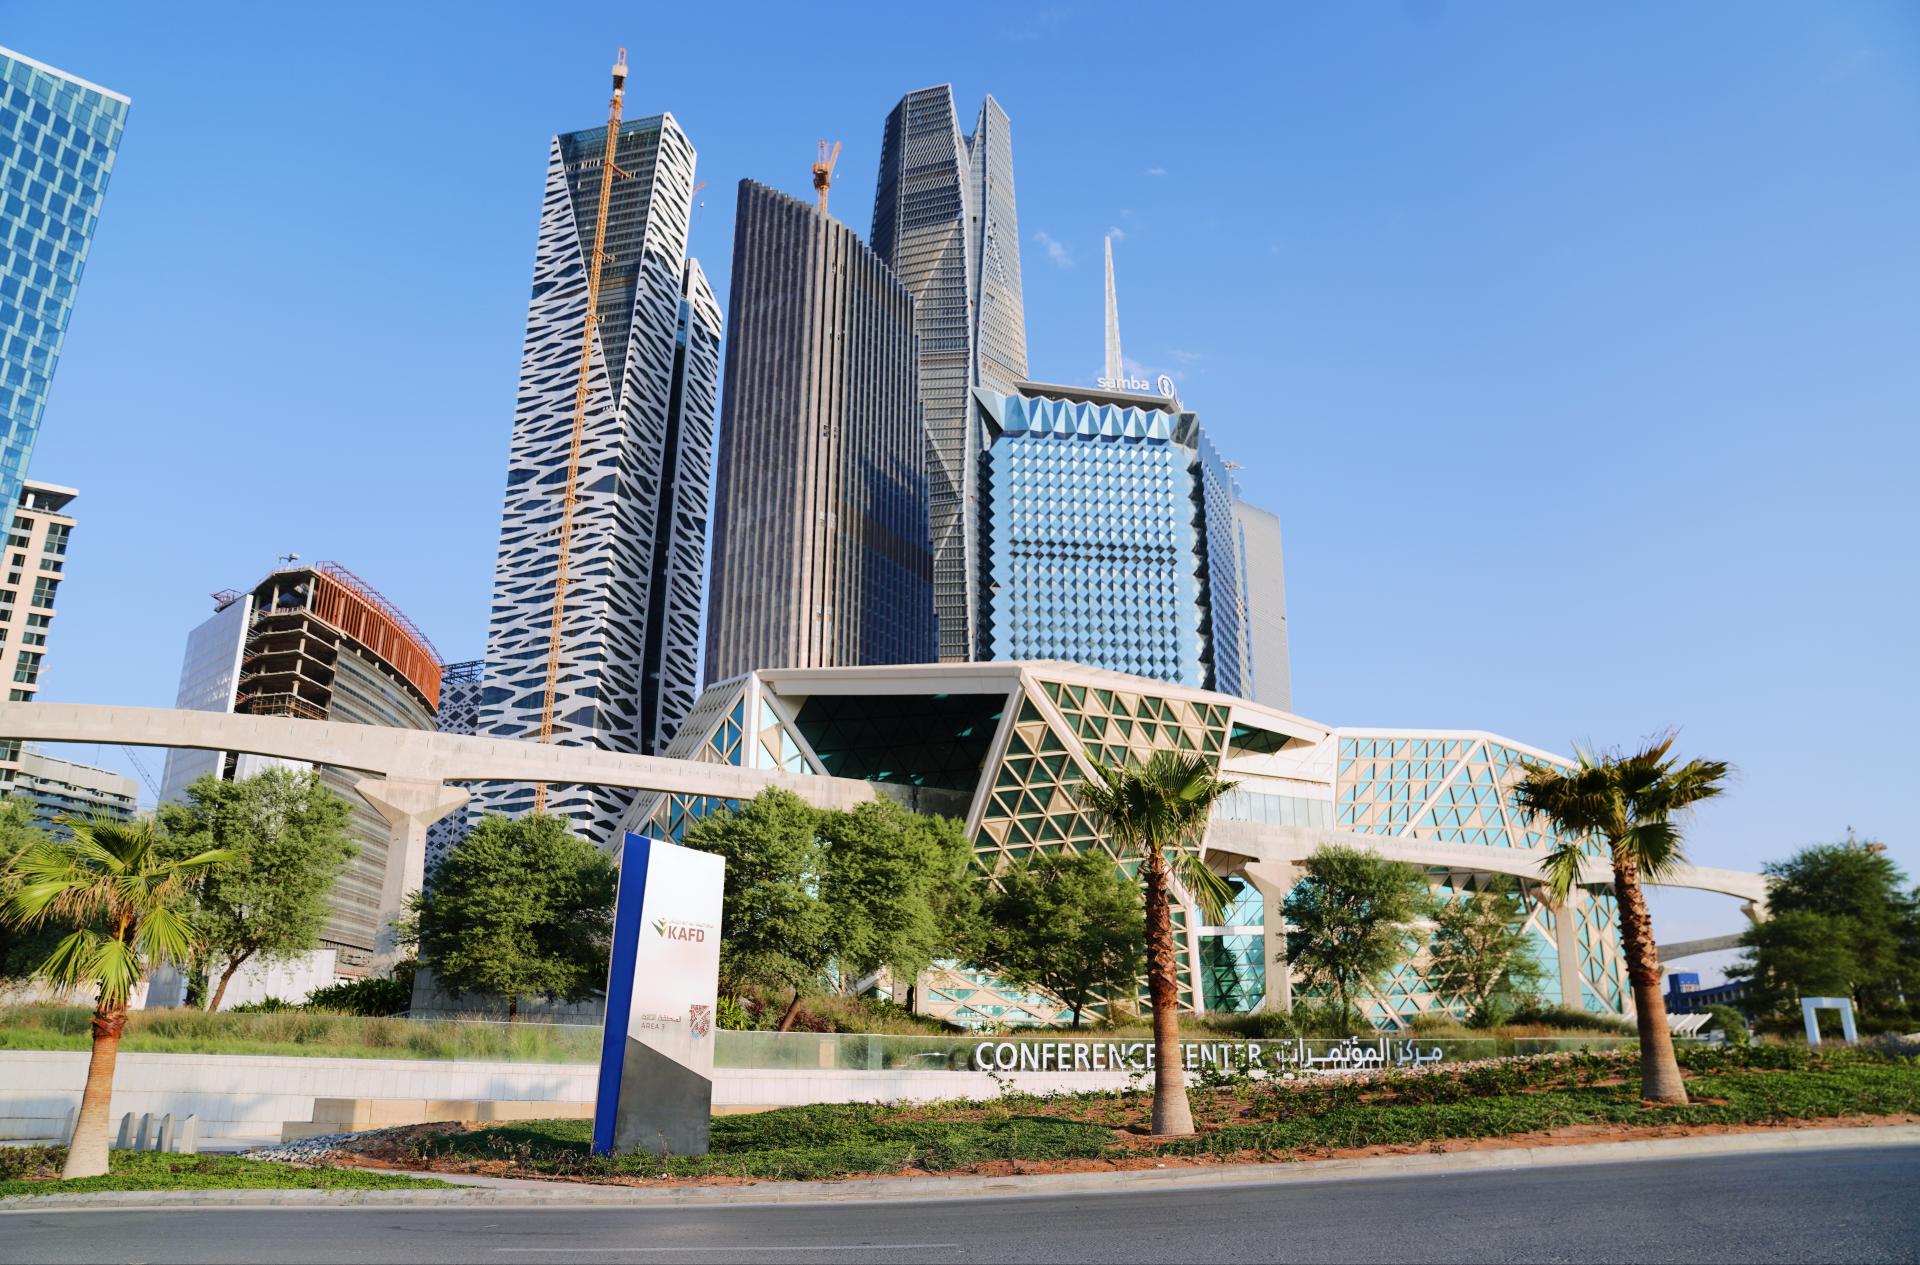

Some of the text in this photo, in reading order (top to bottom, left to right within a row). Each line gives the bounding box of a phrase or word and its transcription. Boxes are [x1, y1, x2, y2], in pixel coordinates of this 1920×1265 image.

[1097, 376, 1150, 391] samba
[668, 926, 705, 942] KAFD
[640, 1022, 660, 1030] AREA
[975, 1042, 1262, 1069] CONFERENCE ENTER
[1276, 1035, 1443, 1067] مركز المؤتمرات
